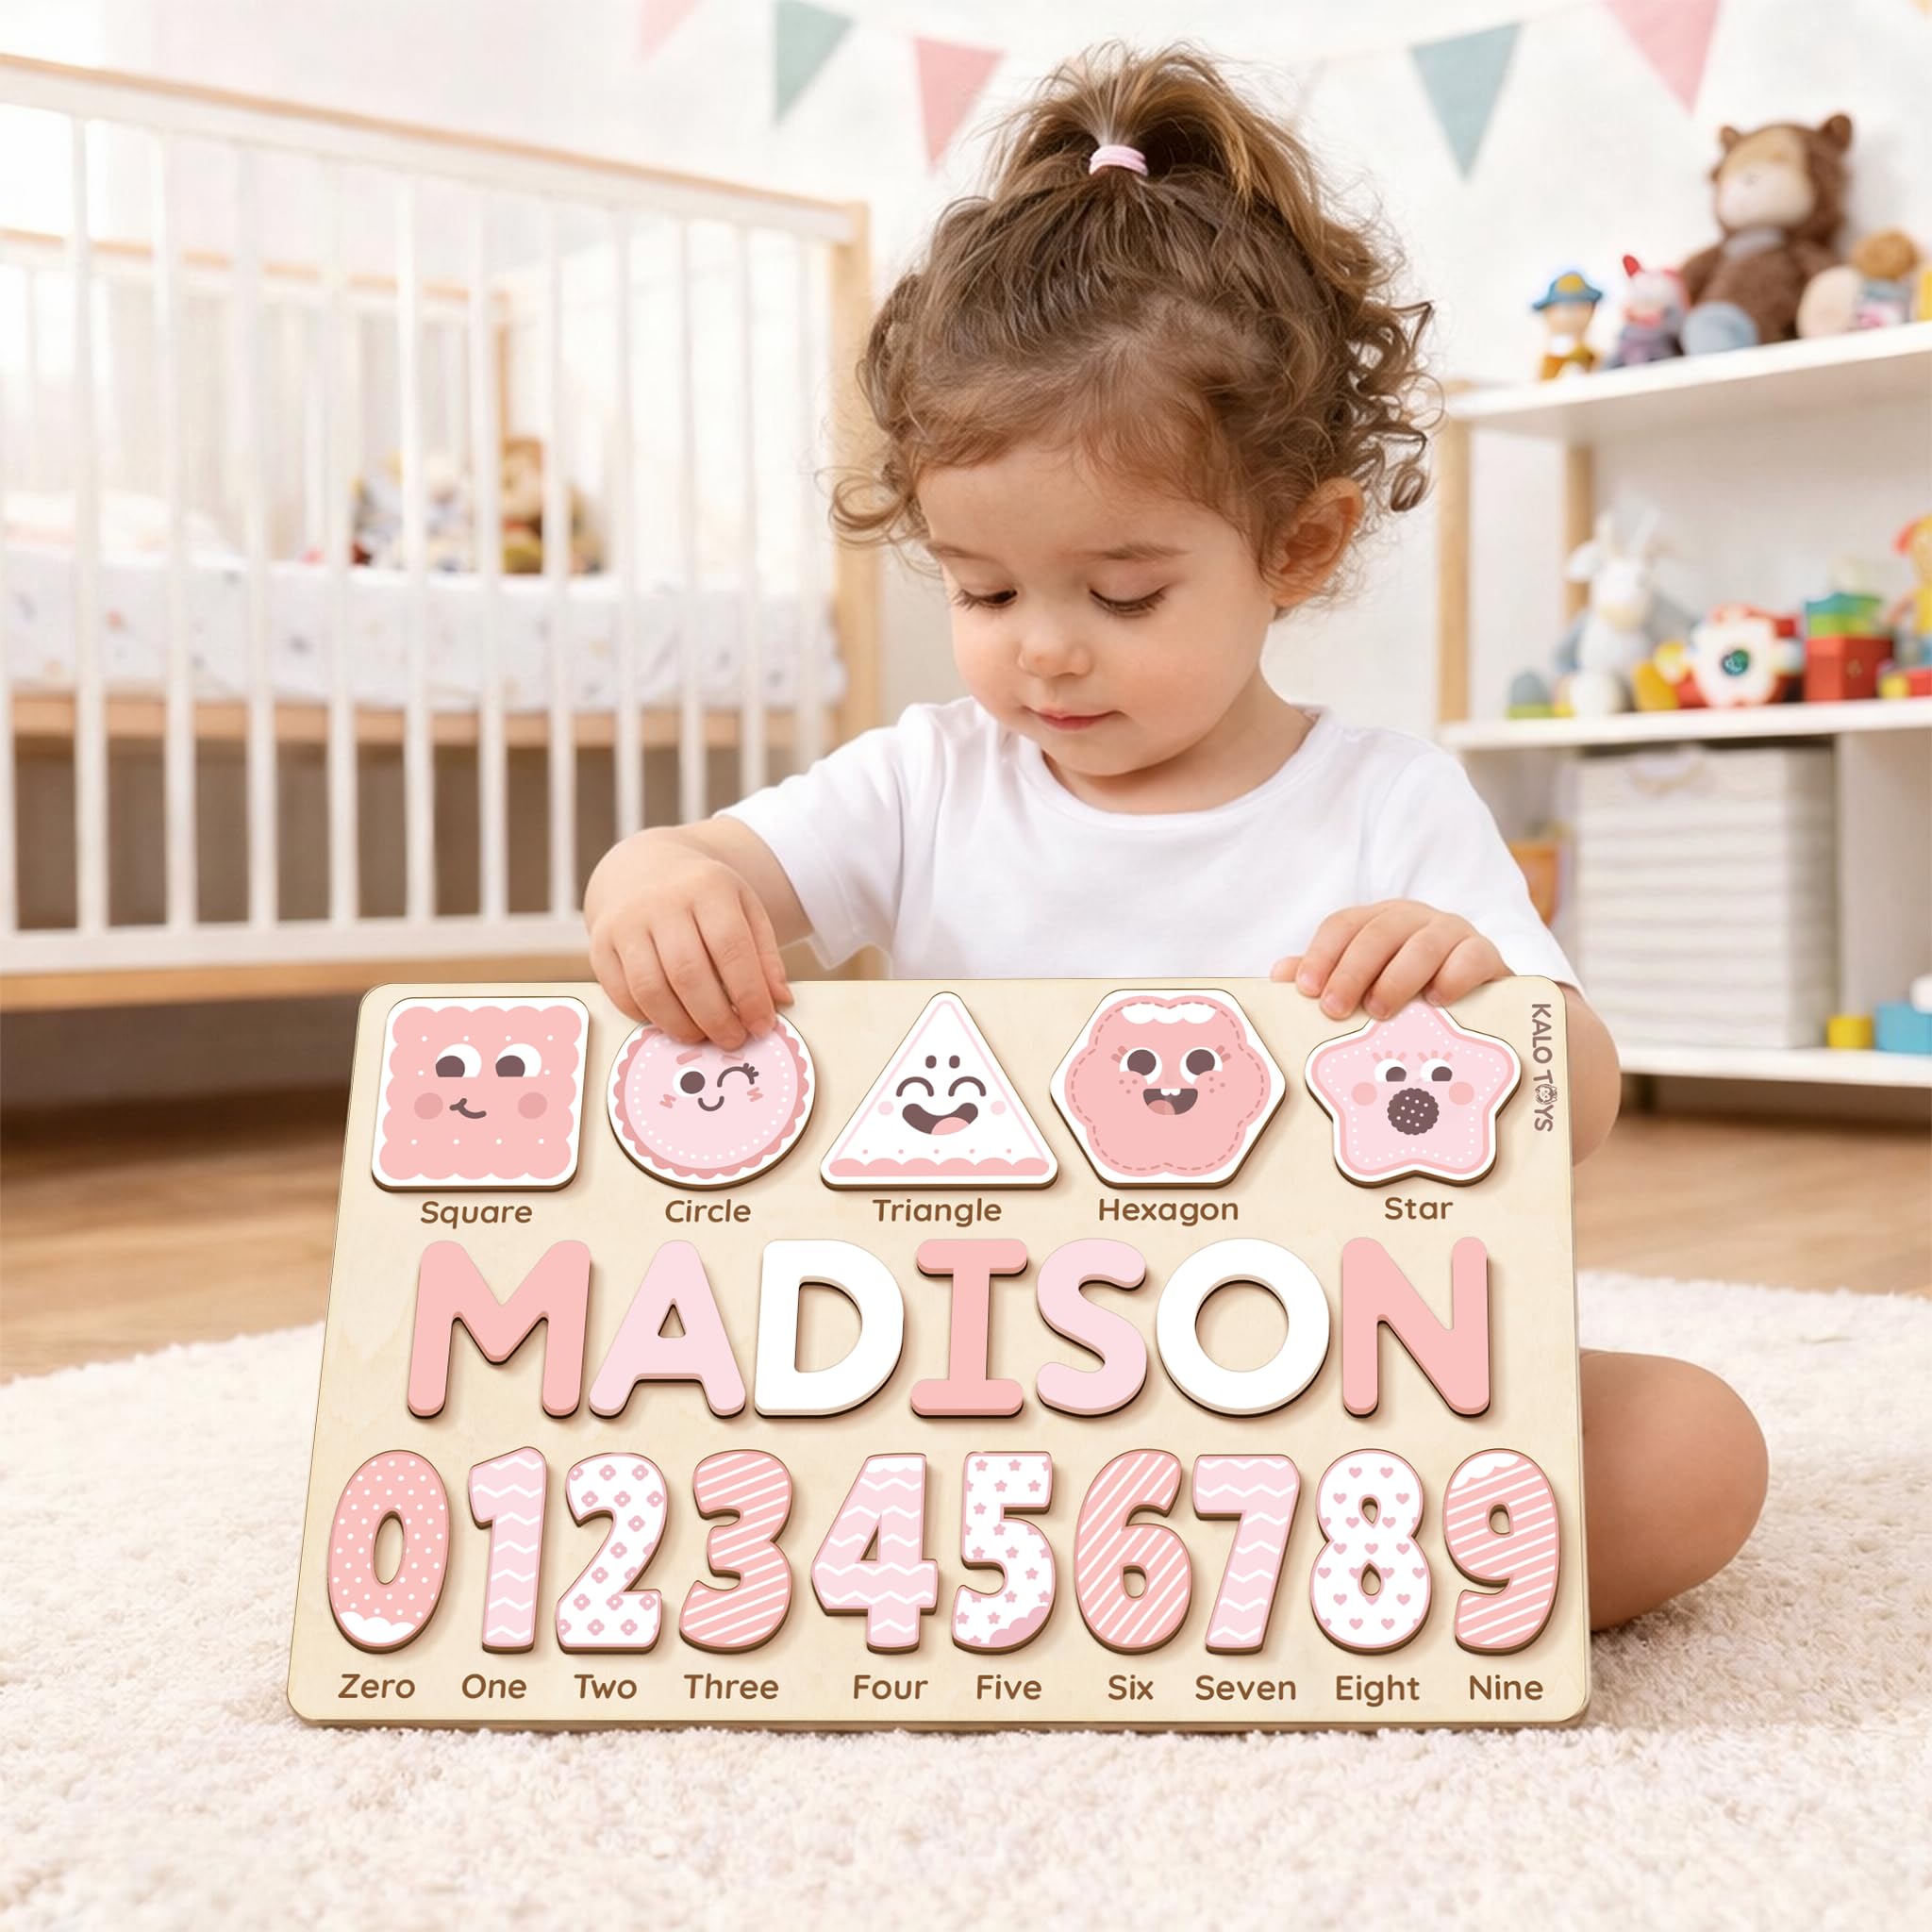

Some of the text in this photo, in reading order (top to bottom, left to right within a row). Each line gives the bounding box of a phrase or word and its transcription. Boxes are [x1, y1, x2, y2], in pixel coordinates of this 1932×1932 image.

[1532, 1004, 1553, 1064] KALO
[421, 1201, 532, 1229] Square
[666, 1199, 751, 1223] Circle
[873, 1198, 1001, 1227] Triangle
[1100, 1199, 1238, 1226] Hexagon
[1385, 1197, 1453, 1220] Star
[407, 1238, 1491, 1419] MADISON
[327, 1446, 1560, 1654] 0 1 2 3 4 5 6 7 8 9
[339, 1674, 415, 1698] Zero
[462, 1674, 526, 1699] One
[575, 1674, 637, 1699] Two
[684, 1674, 778, 1699] Three
[854, 1675, 928, 1699] Four
[977, 1674, 1041, 1700] Five
[1108, 1674, 1153, 1700] Six
[1196, 1675, 1295, 1700] Seven
[1337, 1674, 1419, 1707] Eight
[1470, 1674, 1543, 1700] Nine
